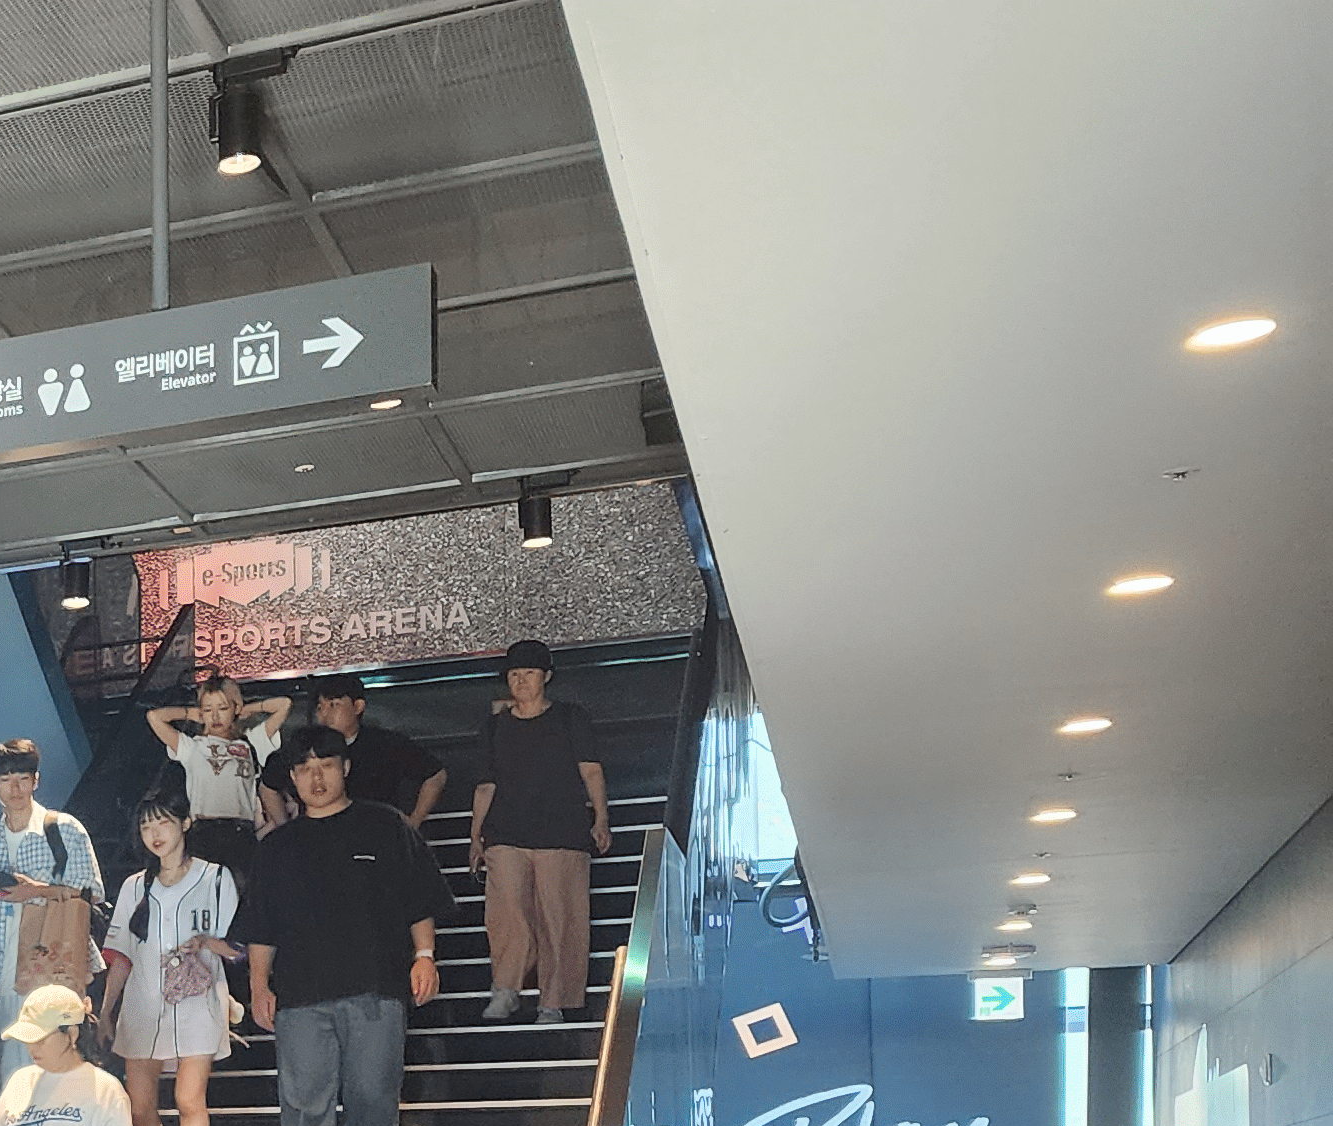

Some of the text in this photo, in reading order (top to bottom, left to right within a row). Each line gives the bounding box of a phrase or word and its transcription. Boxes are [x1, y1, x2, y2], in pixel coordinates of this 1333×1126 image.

[114, 343, 215, 383] 엘리베이터
[161, 370, 216, 392] Elevator
[201, 555, 287, 588] e-Sports
[343, 602, 472, 641] ARENA
[191, 909, 211, 932] 18
